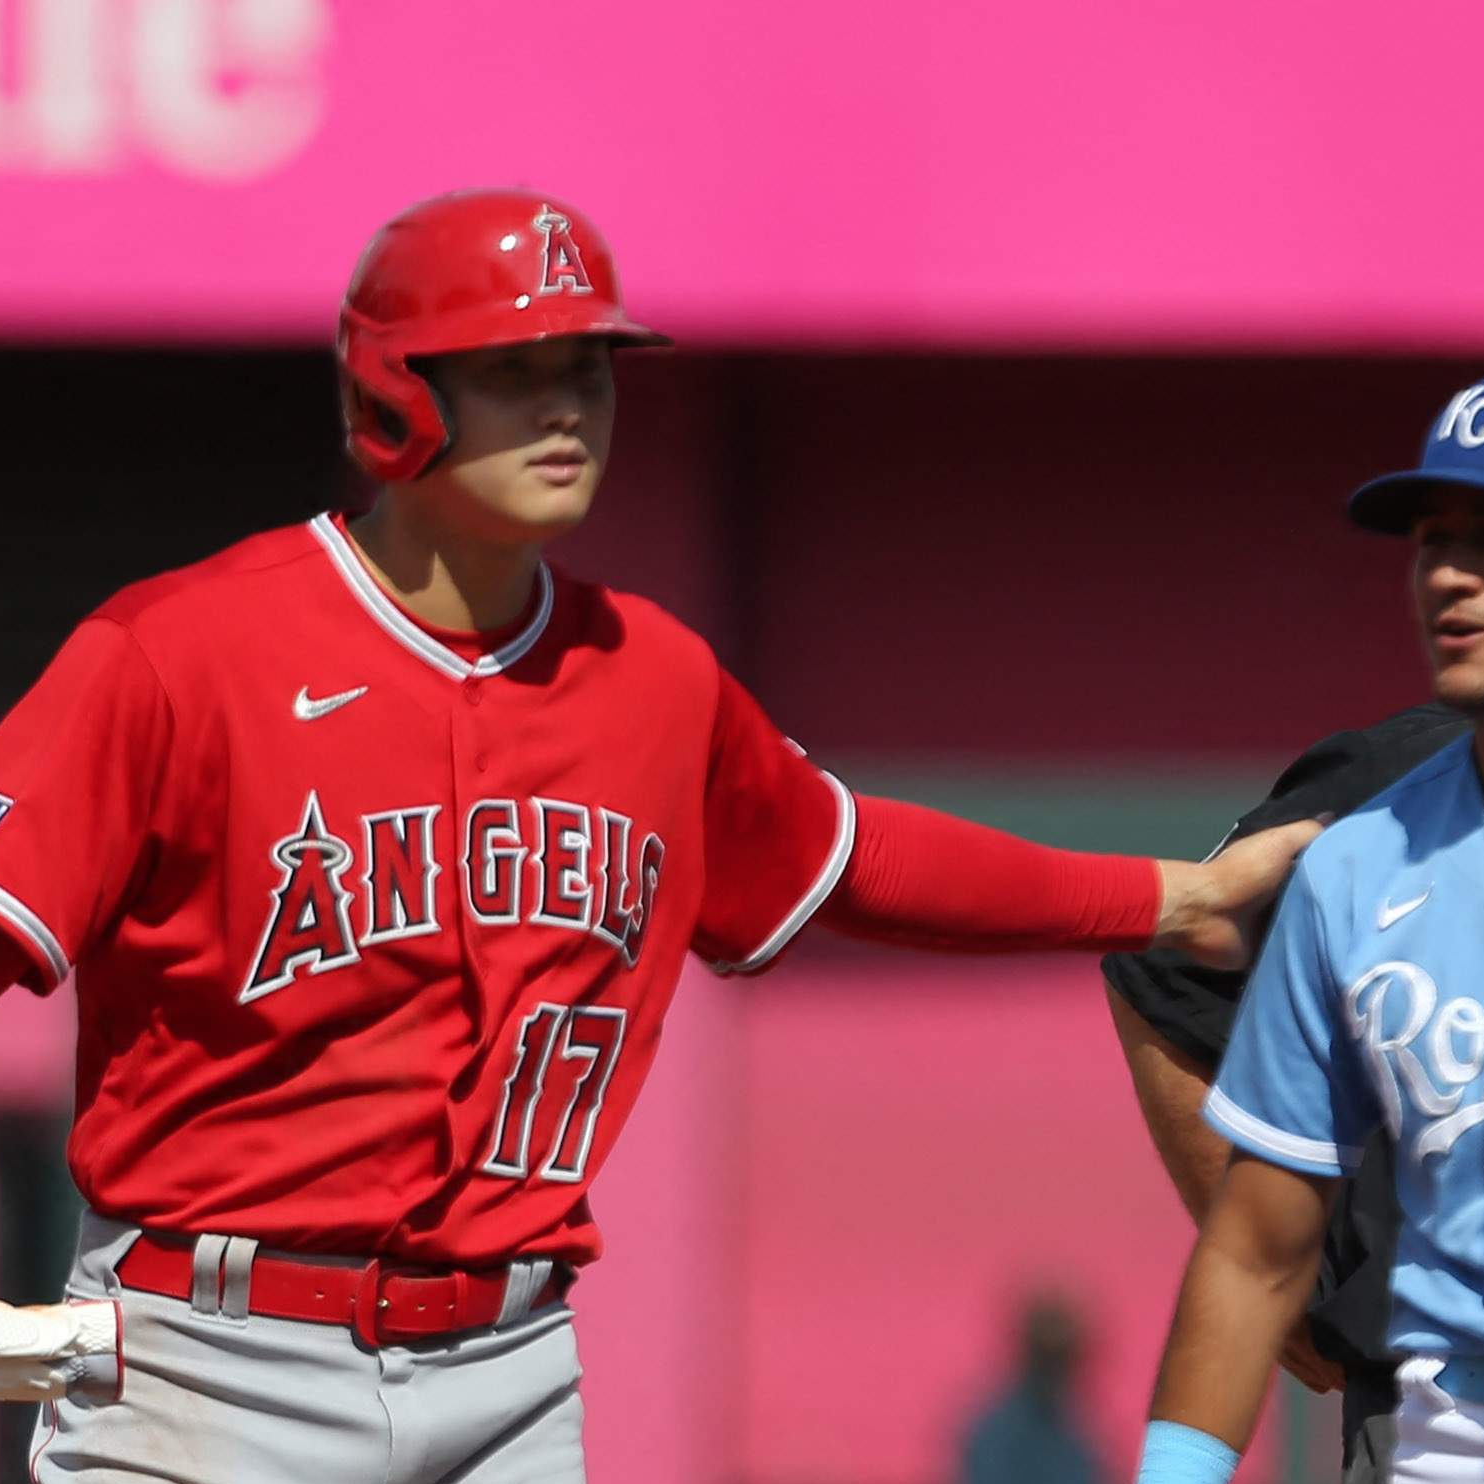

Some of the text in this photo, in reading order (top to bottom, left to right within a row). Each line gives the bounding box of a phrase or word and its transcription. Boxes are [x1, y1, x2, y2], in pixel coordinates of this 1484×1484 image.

[533, 203, 594, 294] A
[238, 788, 665, 1005] ANGELS
[482, 1001, 628, 1182] 17
